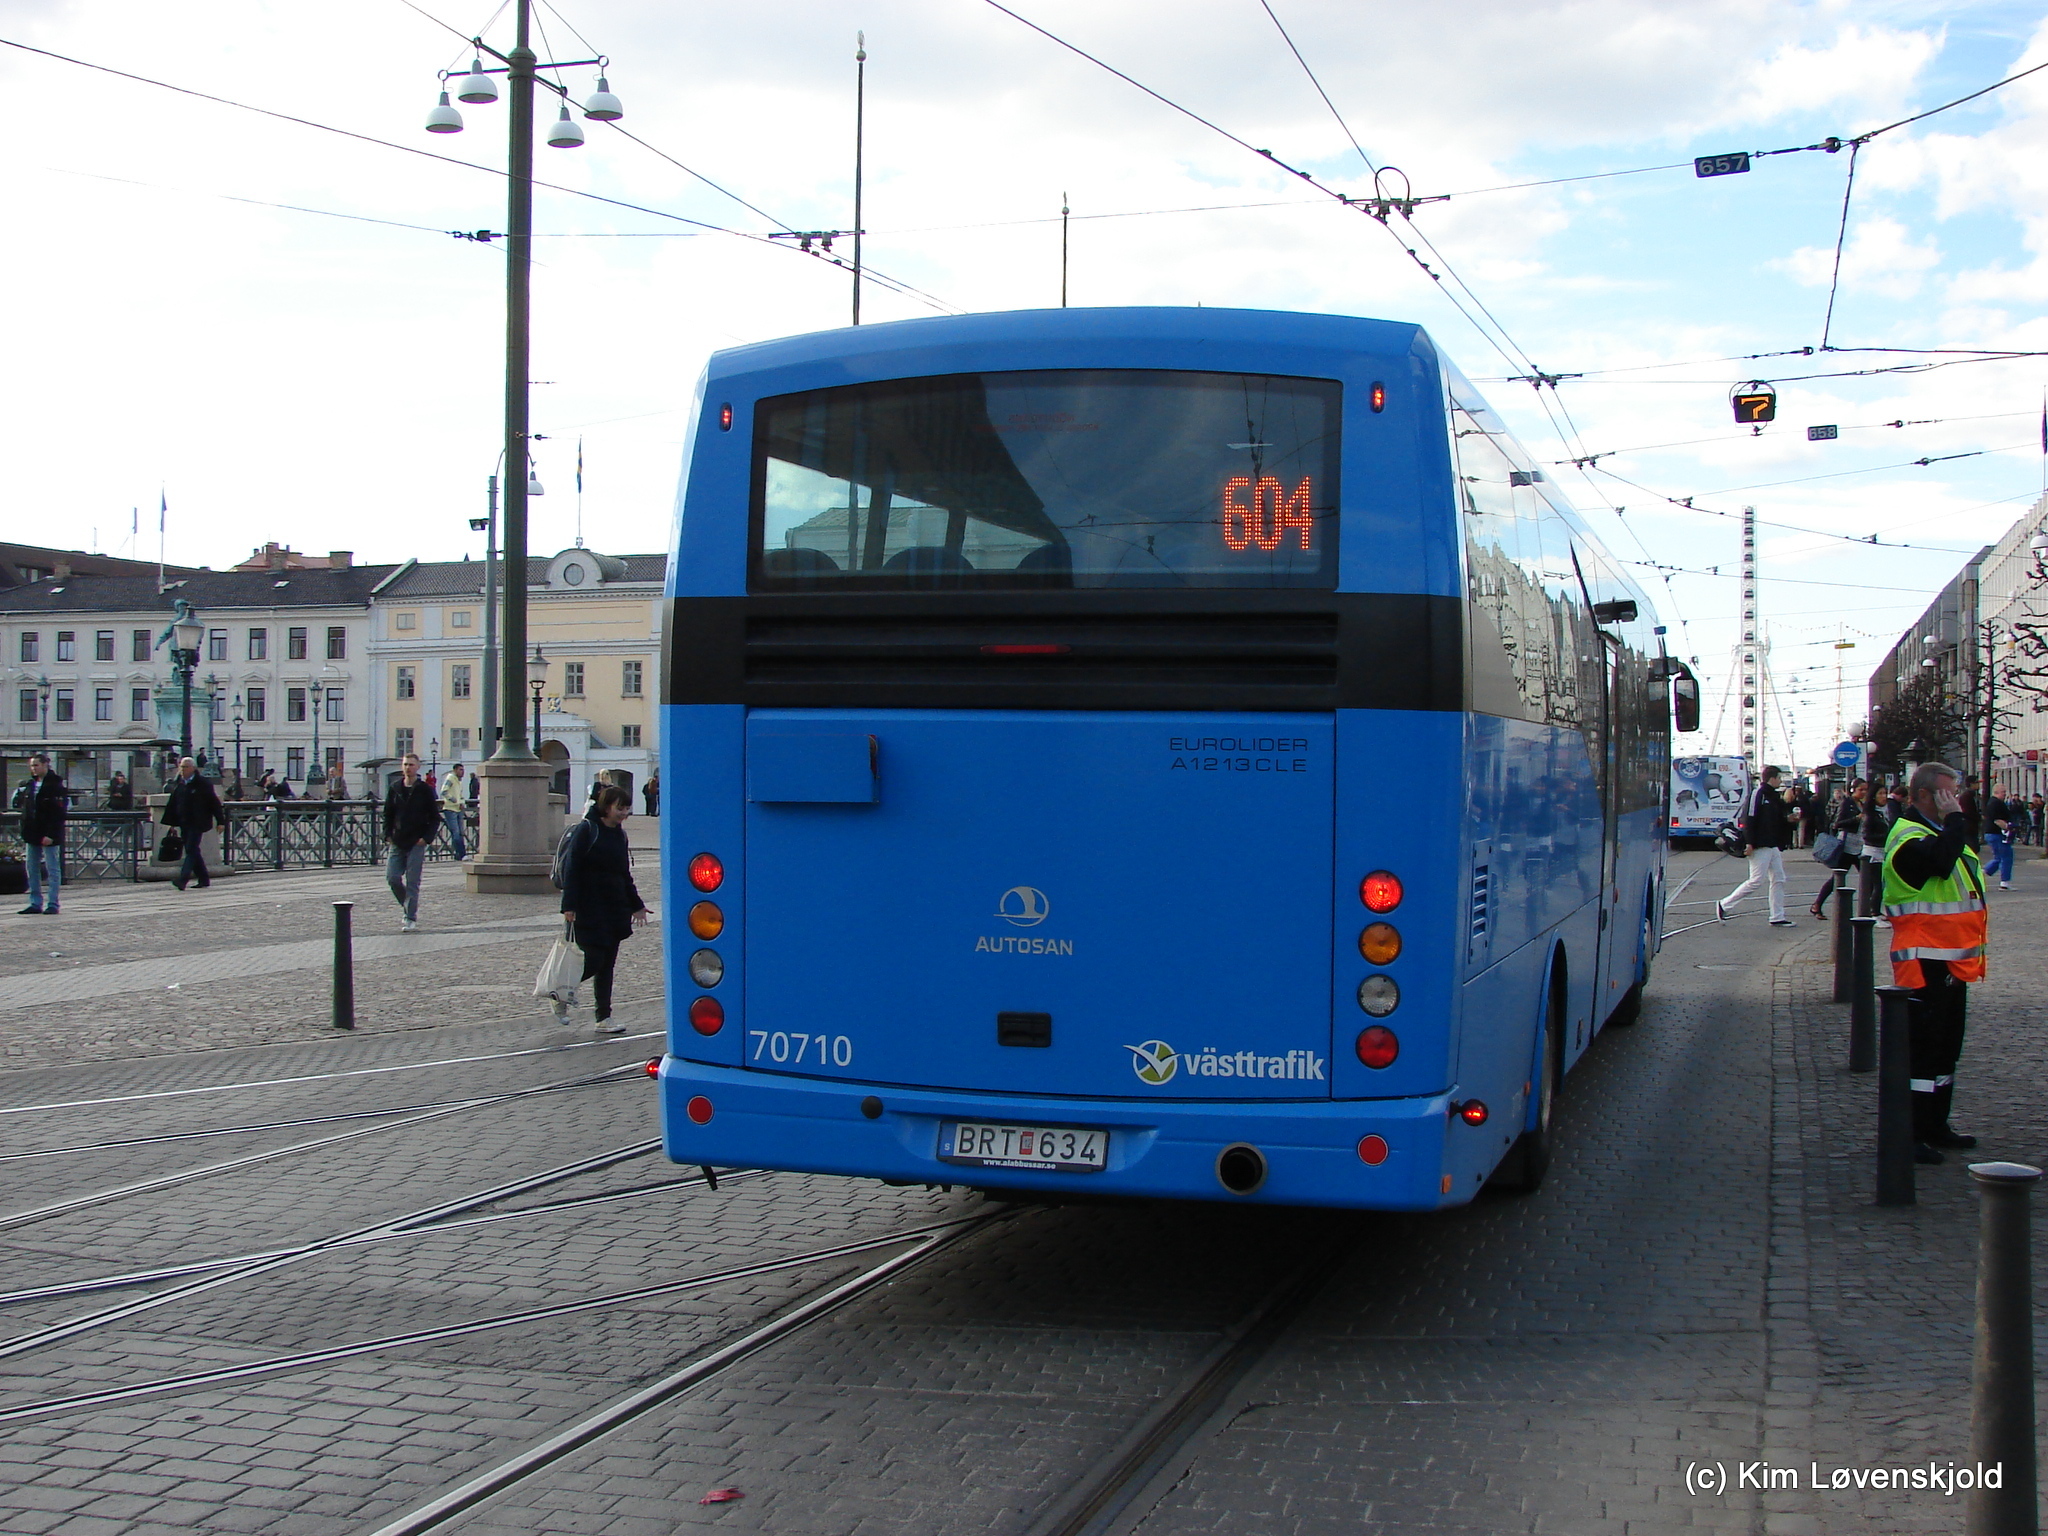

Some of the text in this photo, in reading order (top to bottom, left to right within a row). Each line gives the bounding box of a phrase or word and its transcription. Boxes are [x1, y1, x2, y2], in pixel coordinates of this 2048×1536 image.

[1699, 155, 1746, 175] 657
[1741, 396, 1769, 420] 7
[1810, 427, 1836, 439] 658
[1224, 476, 1313, 550] 604
[1169, 737, 1309, 752] EUROLIDER
[975, 936, 1073, 956] AUTOSAN
[749, 1030, 852, 1067] 70710
[1183, 1046, 1325, 1081] västtrafik
[944, 1142, 951, 1151] S
[958, 1126, 1096, 1162] BRT 634
